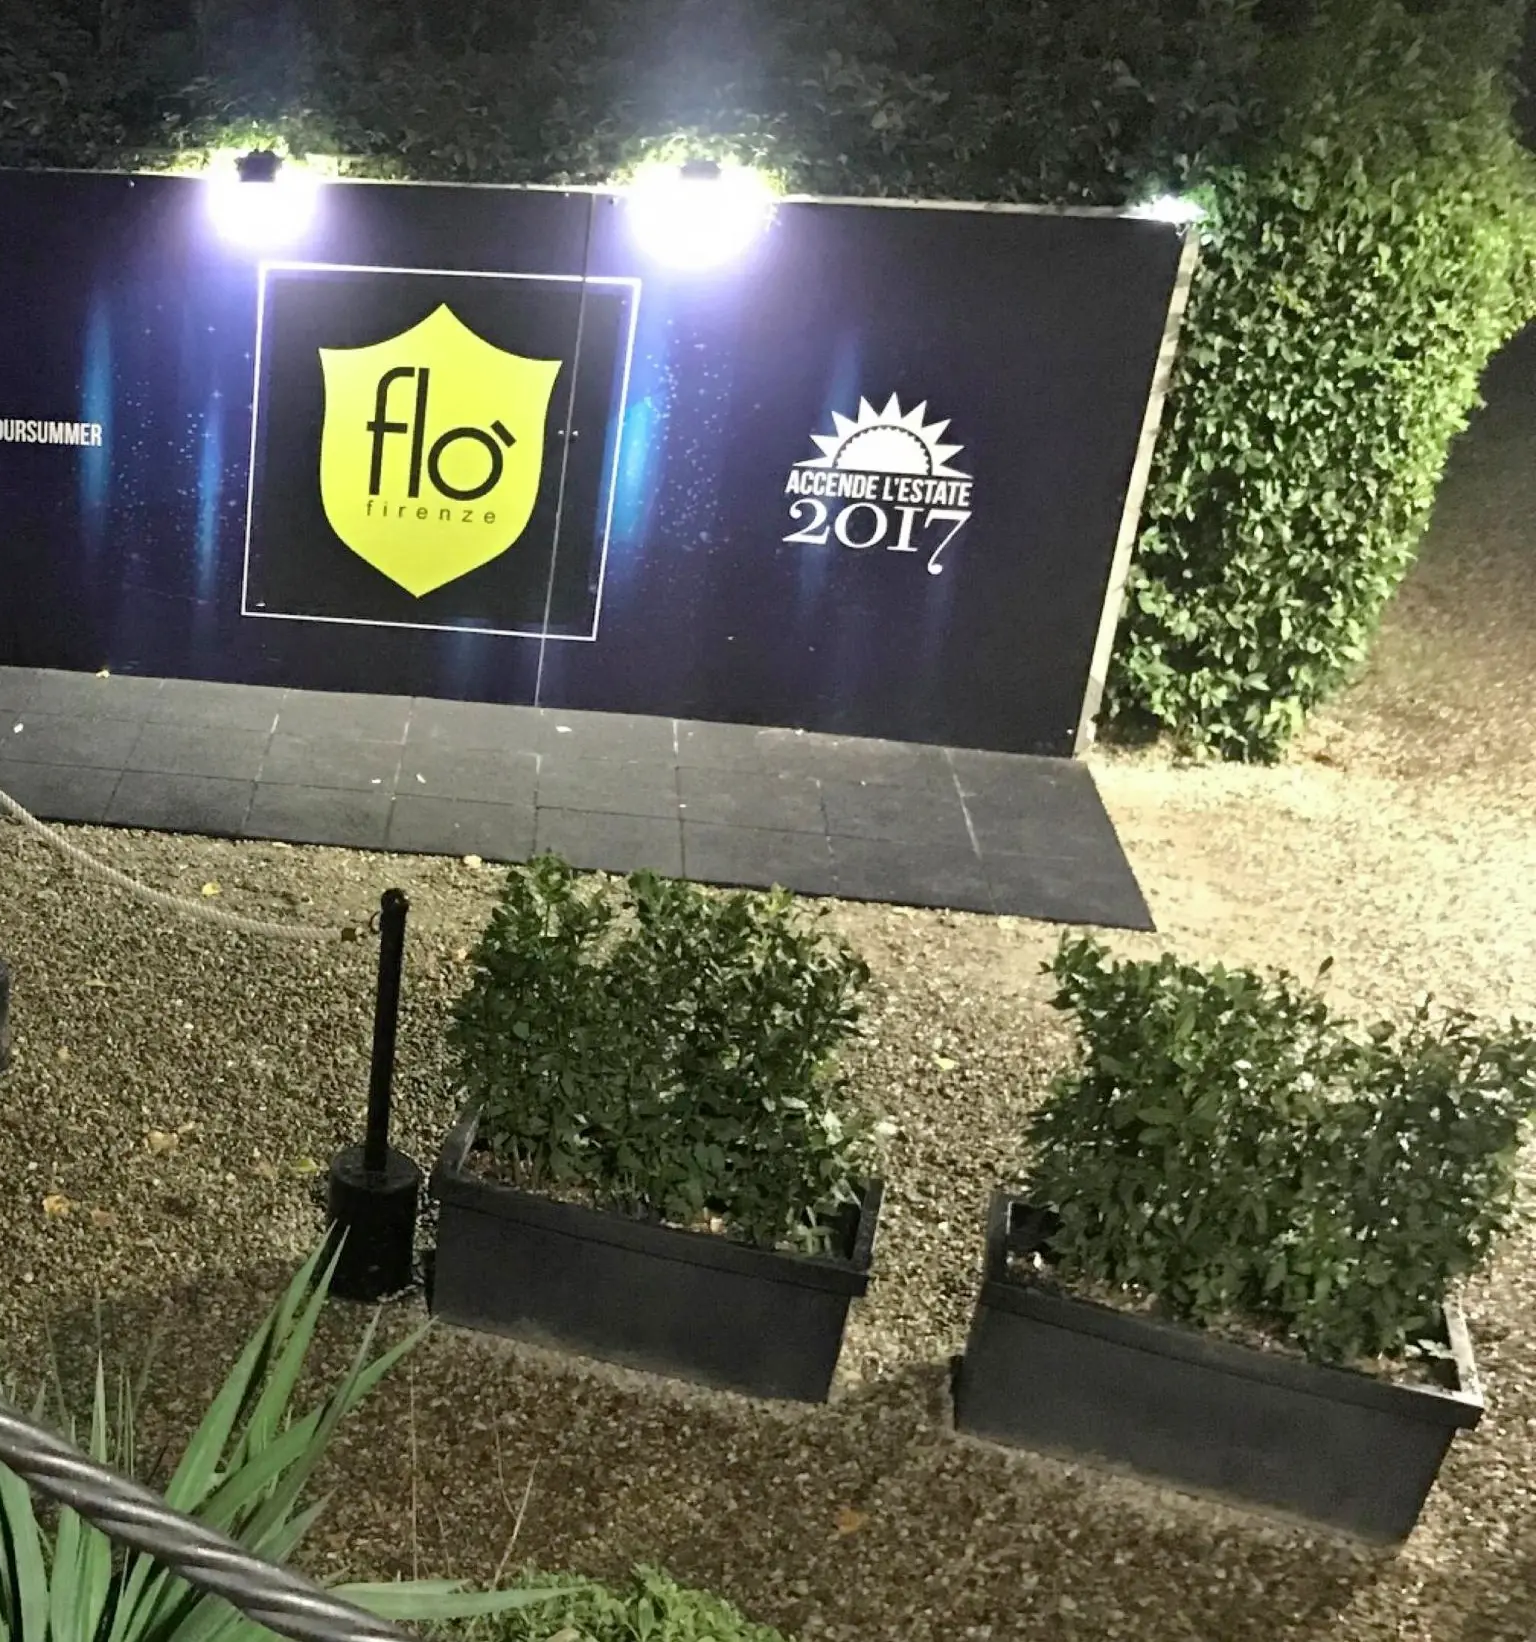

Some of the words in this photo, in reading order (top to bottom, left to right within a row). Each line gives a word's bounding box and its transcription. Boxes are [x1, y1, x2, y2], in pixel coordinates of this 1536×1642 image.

[784, 469, 880, 501] ACCENDE
[881, 476, 974, 507] L'ESTATE
[366, 499, 497, 525] firenze
[781, 498, 973, 576] 2017
